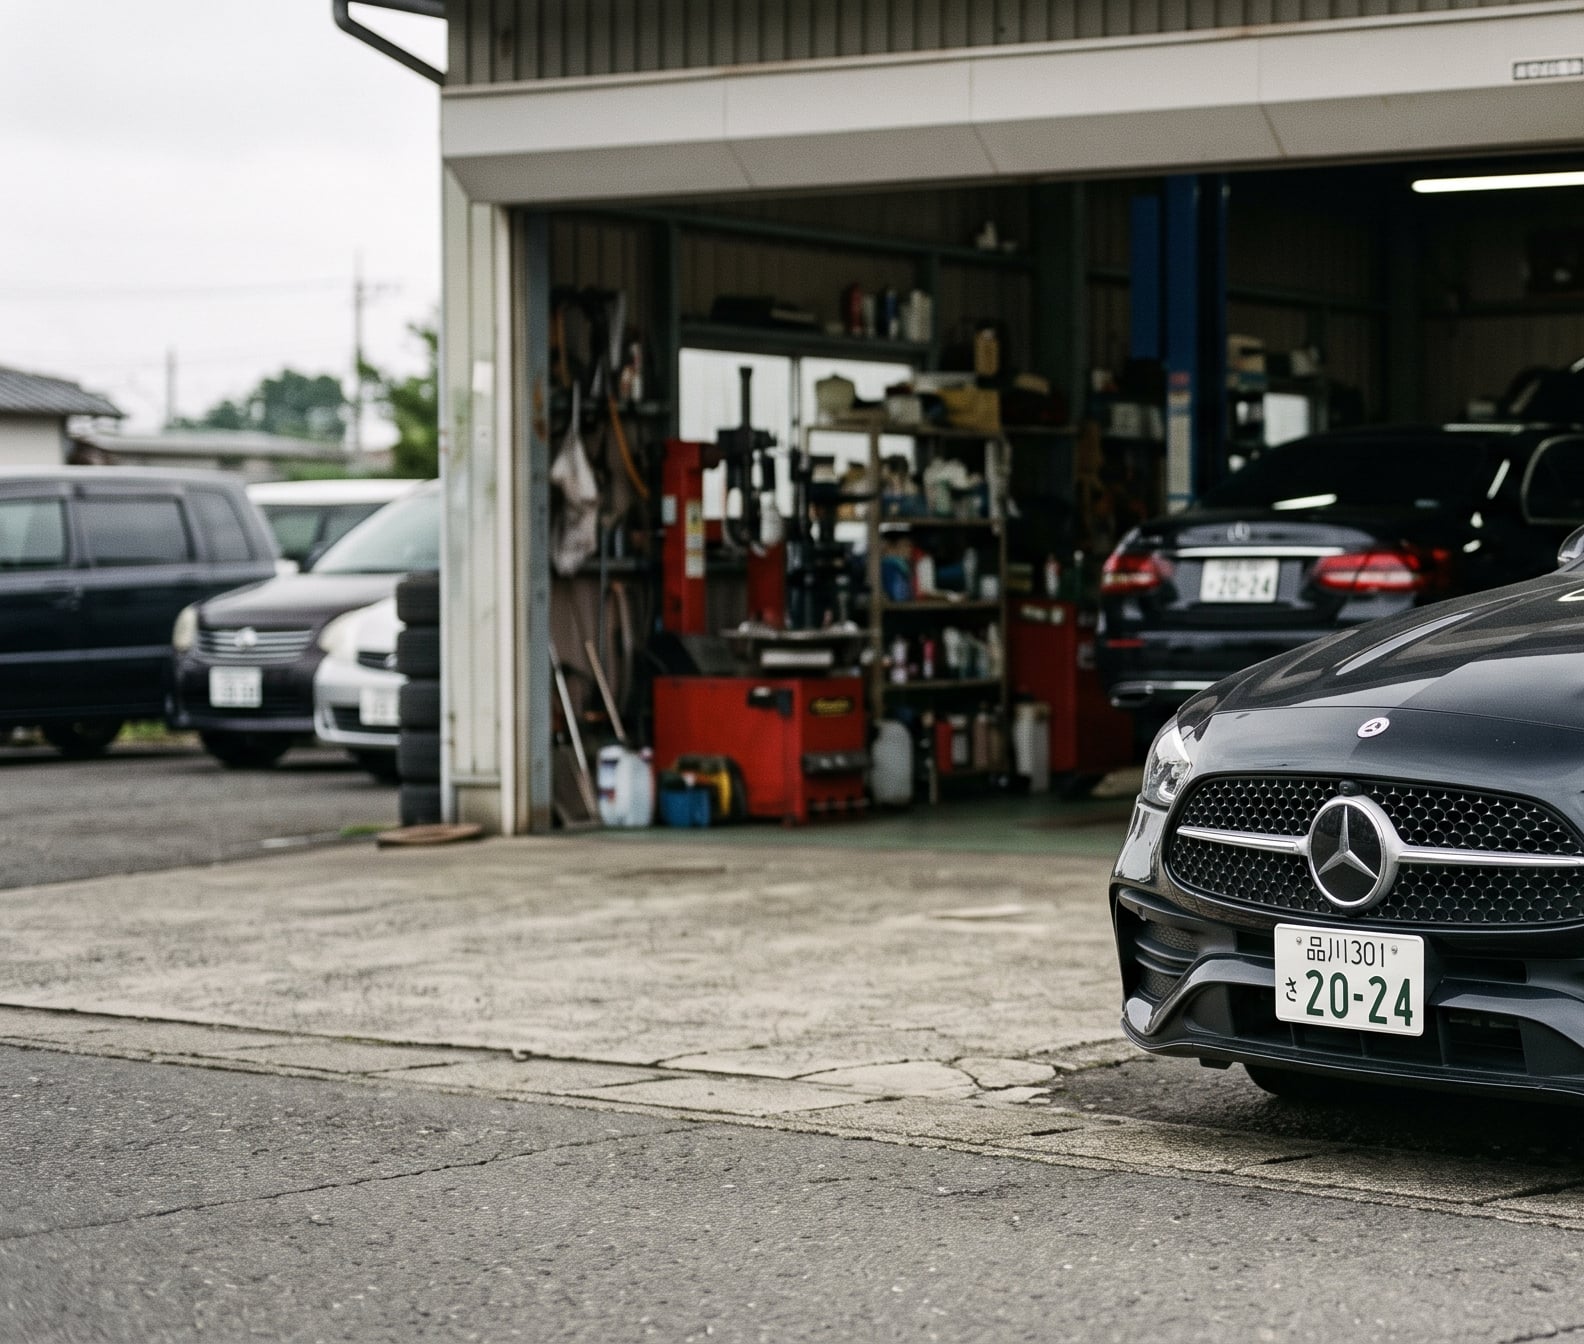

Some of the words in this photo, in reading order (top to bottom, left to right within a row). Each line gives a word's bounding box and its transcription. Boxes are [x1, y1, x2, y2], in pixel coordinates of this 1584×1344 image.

[1306, 936, 1385, 968] 品川301
[1285, 976, 1298, 1003] さ
[1305, 969, 1414, 1027] 20-24
